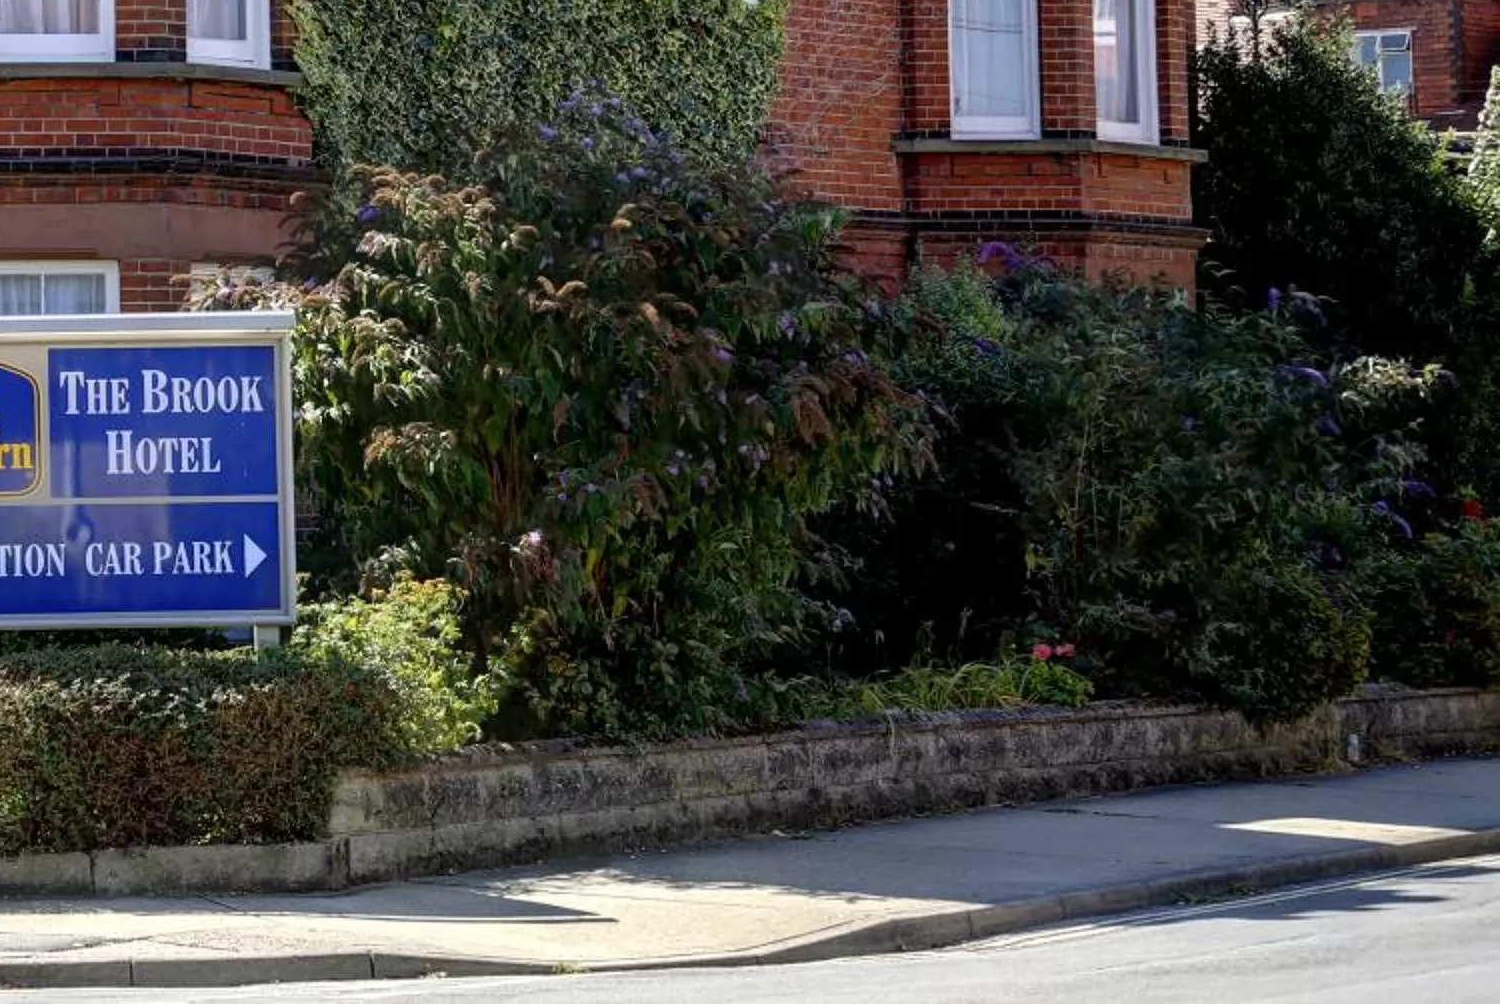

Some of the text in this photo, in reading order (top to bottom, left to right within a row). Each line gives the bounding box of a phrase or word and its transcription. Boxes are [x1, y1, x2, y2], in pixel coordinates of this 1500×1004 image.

[59, 369, 264, 415] THE BROOK
[106, 430, 221, 476] HOTEL
[85, 542, 144, 576] CAR
[154, 540, 234, 575] PARK
